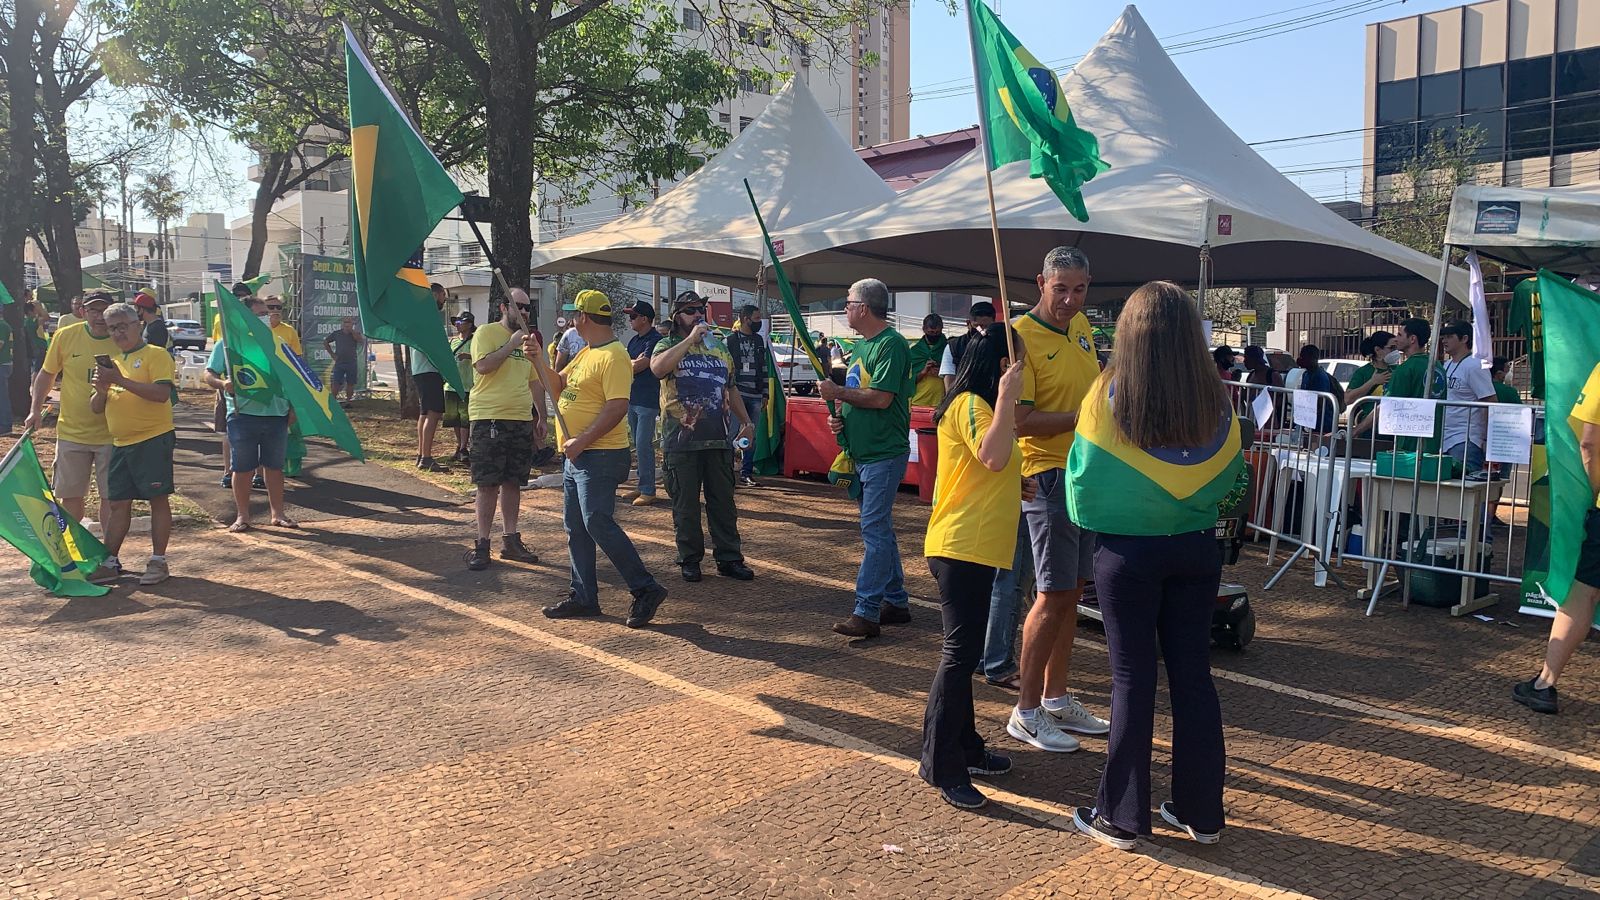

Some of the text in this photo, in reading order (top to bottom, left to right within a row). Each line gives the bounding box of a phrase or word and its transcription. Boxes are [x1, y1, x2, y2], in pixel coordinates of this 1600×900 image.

[312, 260, 331, 273] Sept.
[314, 280, 340, 291] BRAZIL
[326, 293, 348, 304] NO TO
[313, 305, 359, 317] COMMUNISM
